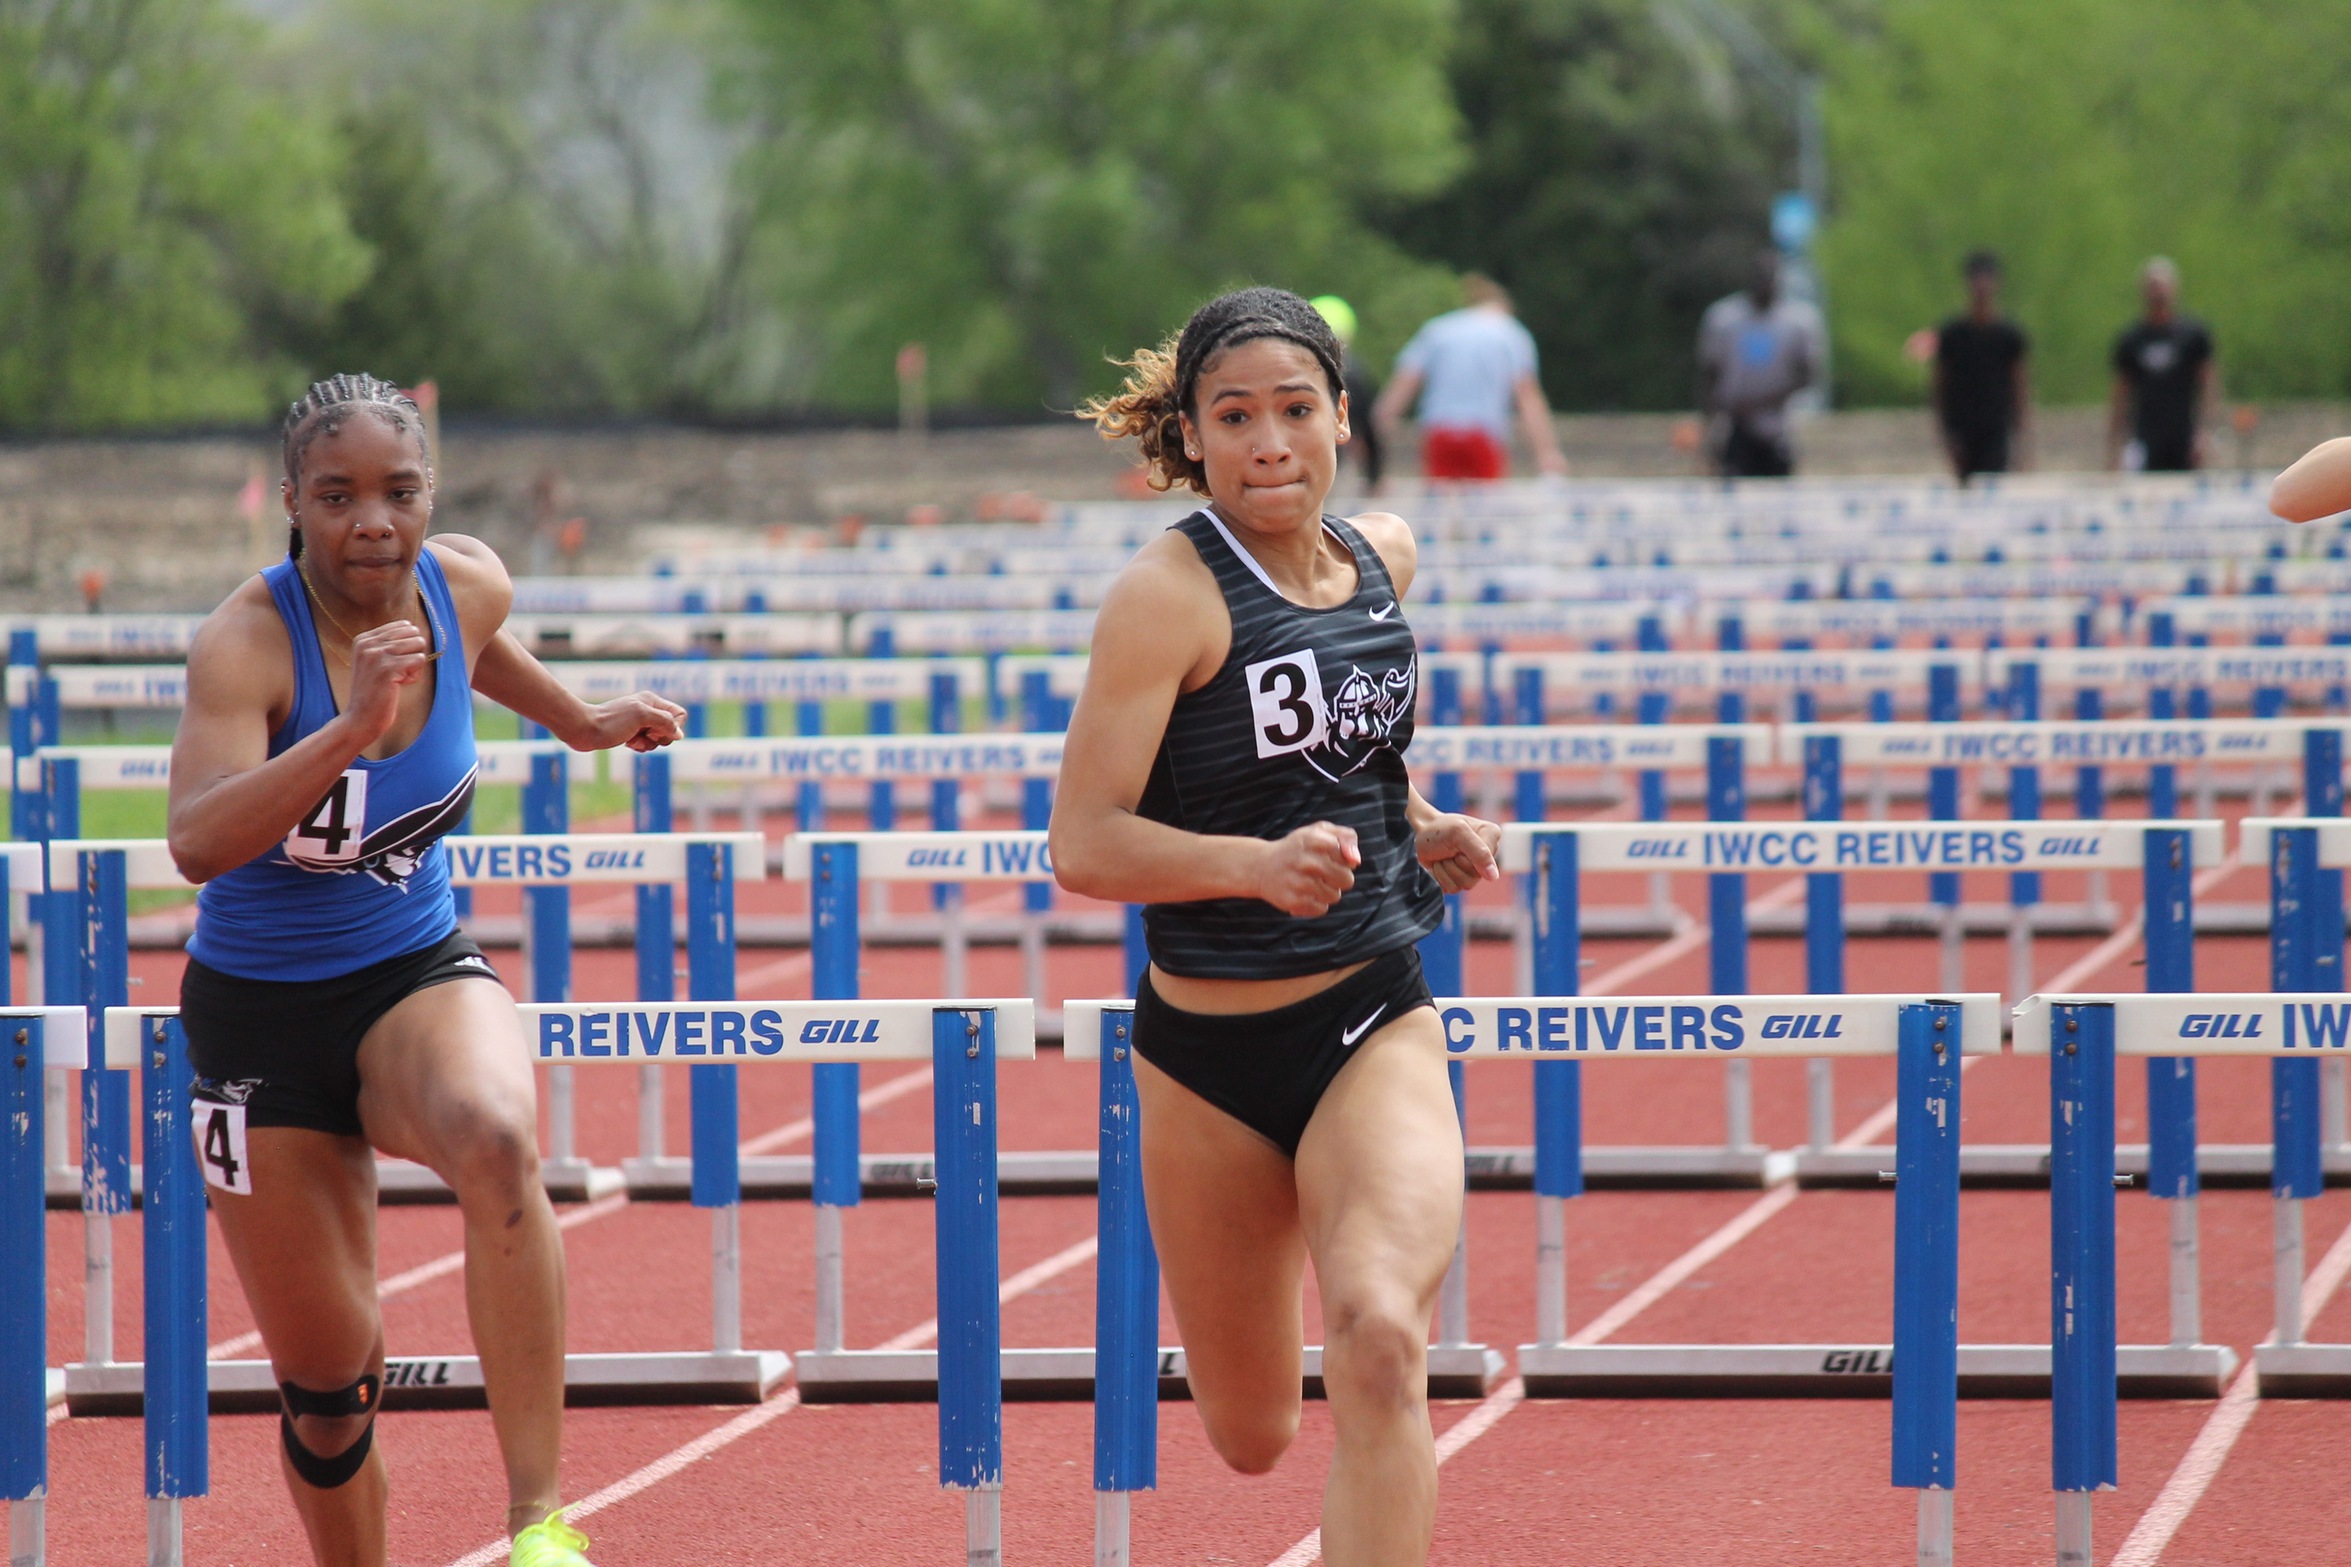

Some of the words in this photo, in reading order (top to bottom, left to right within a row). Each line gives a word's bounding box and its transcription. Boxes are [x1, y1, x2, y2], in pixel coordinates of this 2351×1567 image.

[1260, 663, 1314, 746] 3
[772, 749, 859, 773] IWCC
[877, 746, 1026, 776] REIVERS
[1466, 738, 1613, 763] REIVERS
[1945, 734, 2035, 760] IWCC
[2053, 731, 2206, 758] REIVERS
[297, 776, 351, 855] 4
[586, 852, 644, 868] GILL
[908, 850, 965, 866] GILL
[1627, 841, 1686, 858] GILL
[1704, 832, 1816, 865] IWCC
[1837, 831, 2024, 864] REIVERS
[2039, 839, 2098, 855] GILL
[540, 1010, 783, 1056] REIVERS
[800, 1020, 879, 1043] GILL
[1498, 1005, 1744, 1051] REIVERS
[1761, 1015, 1841, 1038] GILL
[2179, 1014, 2261, 1037] GILL
[2283, 1004, 2351, 1047] IW
[204, 1109, 239, 1187] 4
